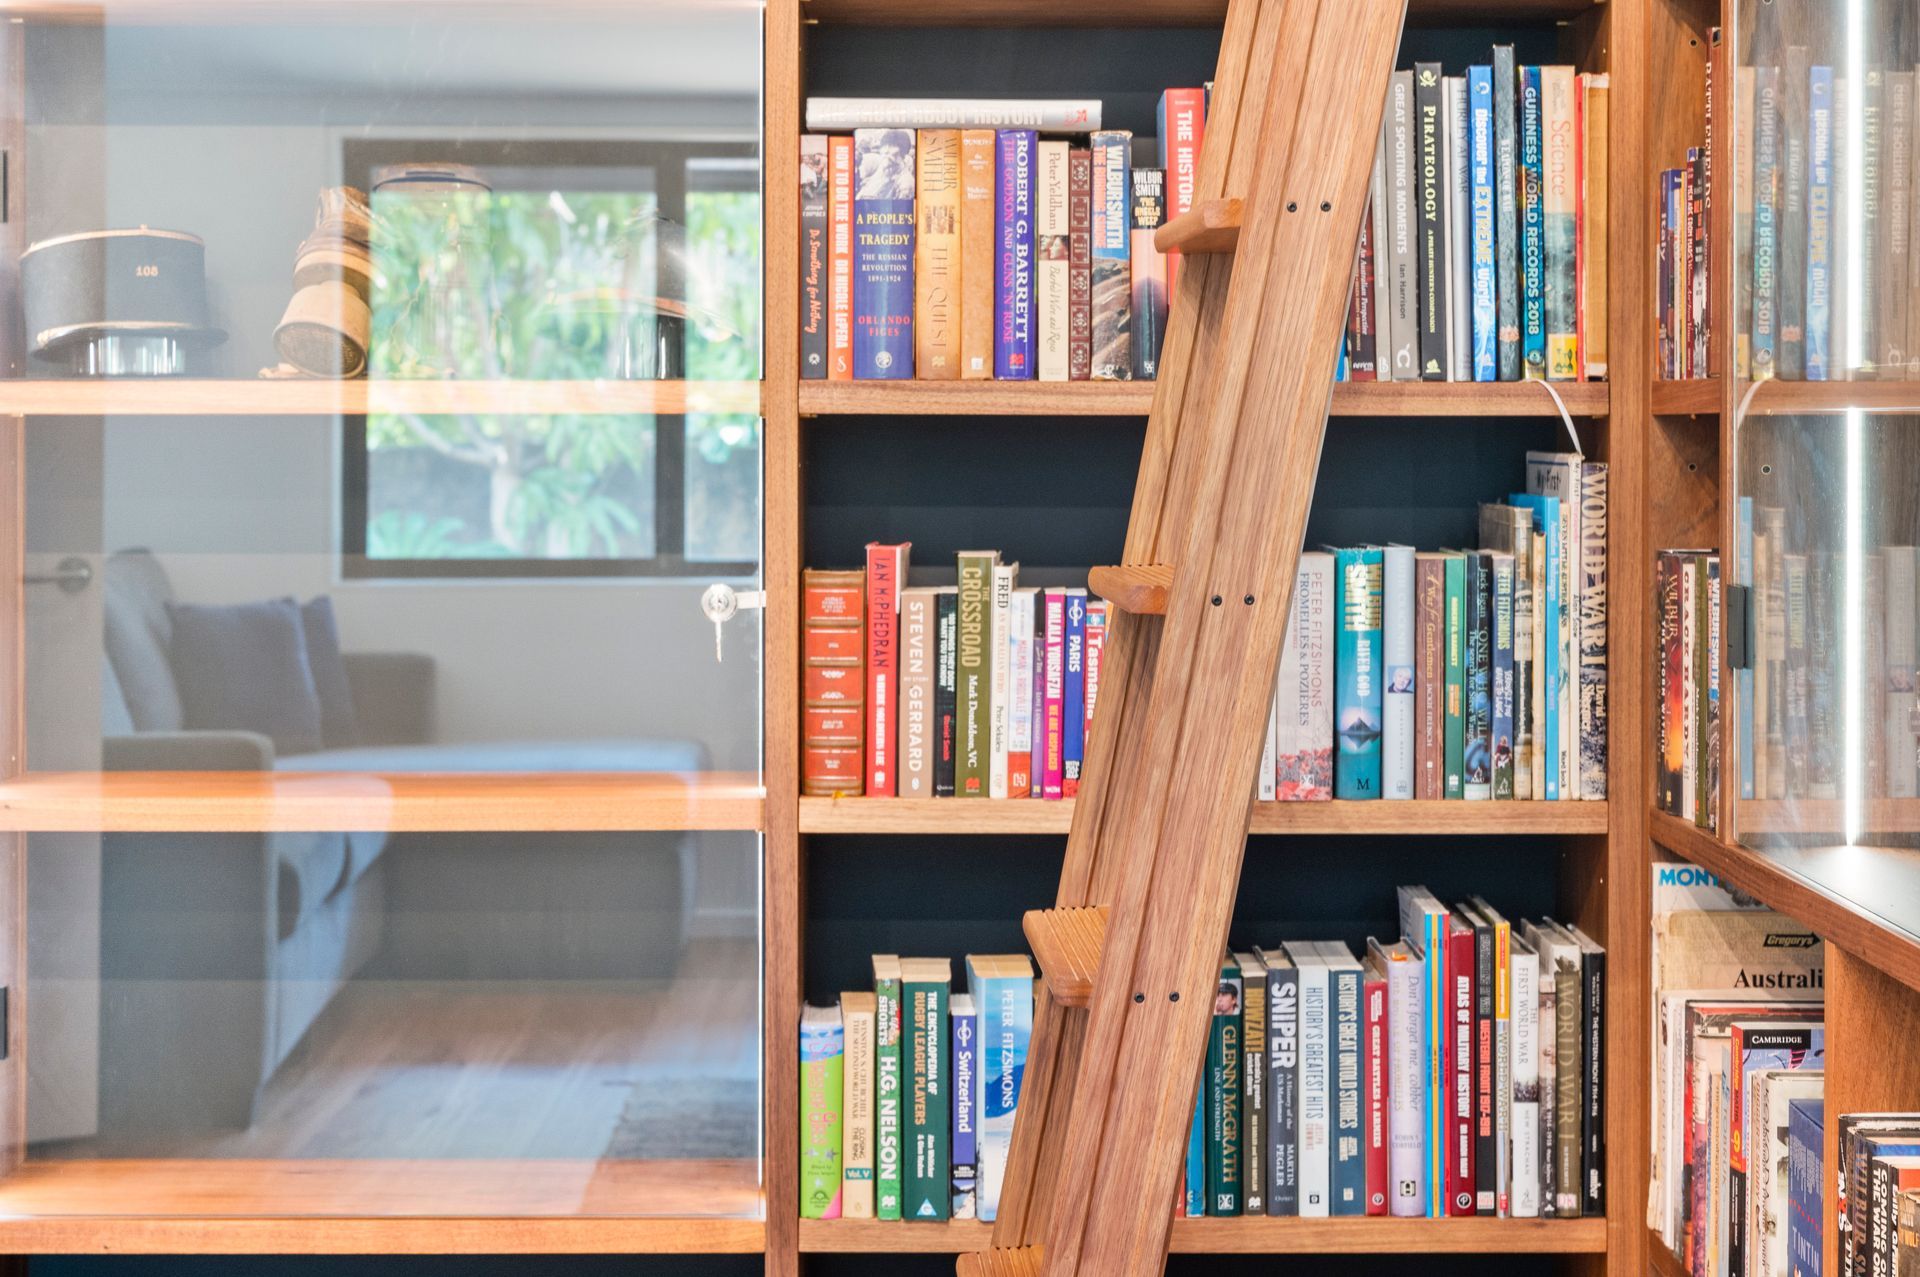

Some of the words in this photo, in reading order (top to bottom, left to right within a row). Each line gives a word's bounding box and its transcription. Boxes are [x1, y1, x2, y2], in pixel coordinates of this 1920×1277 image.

[1395, 83, 1405, 123] GREAT
[1177, 110, 1193, 142] THE
[1475, 108, 1488, 165] Discover
[1525, 87, 1537, 164] GUINNESS
[835, 145, 849, 170] HOW
[924, 136, 944, 192] SMITH
[943, 137, 958, 190] WILBUR
[1003, 139, 1015, 163] THE
[1049, 152, 1061, 180] Peter
[1396, 126, 1406, 187] SPORTING
[1423, 105, 1437, 221] PIRATEOLOGY
[1551, 121, 1571, 195] Science
[835, 172, 849, 185] TO
[835, 187, 849, 201] DO
[1016, 139, 1028, 215] ROBERT
[1133, 171, 1162, 184] WILBUR
[1135, 184, 1160, 196] SMITH
[1476, 167, 1487, 184] the
[835, 202, 849, 222] THE
[1003, 168, 1014, 222] GODSON
[1049, 180, 1063, 230] Yeldham
[1526, 167, 1538, 223] WORLD
[857, 213, 863, 225] A
[867, 213, 913, 225] PEOPLE'S
[1004, 226, 1013, 248] AND
[1016, 220, 1028, 238] G.
[1397, 190, 1407, 254] MOMENTS
[1476, 186, 1491, 265] EXTREME
[835, 223, 849, 254] WORK
[859, 234, 910, 245] TRAGEDY
[862, 264, 907, 272] REVOLUTION
[1003, 252, 1014, 288] GUNS
[1527, 227, 1539, 297] RECORDS
[1016, 243, 1028, 343] BARRETT
[1399, 281, 1407, 319] Harrison
[1477, 268, 1490, 306] World
[804, 300, 821, 334] Nothing
[858, 315, 910, 325] ORLANDO
[869, 327, 899, 336] FIGES
[1002, 311, 1014, 344] ROSE
[1528, 301, 1540, 335] 2018
[1581, 472, 1606, 574] WORLD
[874, 557, 891, 582] IAN
[1478, 568, 1488, 589] Jack
[1498, 567, 1510, 594] PETER
[982, 586, 990, 601] THE
[998, 576, 1009, 608] FRED
[1300, 572, 1310, 649] FROMELLES
[1311, 572, 1322, 615] PETER
[1476, 592, 1488, 618] Egan
[1670, 575, 1678, 639] WILBUR
[962, 567, 982, 667] CROSSROAD
[1047, 601, 1061, 644] MALALA
[1498, 597, 1510, 650] FITZSIMONS
[1581, 584, 1606, 656] WAR
[909, 601, 924, 672] STEVEN
[1069, 634, 1080, 672] PARIS
[1426, 623, 1436, 678] Gentlemen
[1469, 629, 1478, 646] The
[1300, 652, 1307, 661] &
[1311, 621, 1322, 707] FITZSIMONS
[1357, 640, 1370, 673] RIVER
[968, 674, 978, 699] Mark
[1357, 675, 1370, 696] GOD
[1468, 679, 1477, 689] for
[909, 685, 924, 772] GERRARD
[1408, 976, 1420, 1007] Don't
[1458, 976, 1470, 1008] ATLAS
[1518, 968, 1528, 994] FIRST
[1734, 968, 1823, 988] Australi
[914, 992, 926, 1029] RUGBY
[928, 992, 938, 1010] THE
[1002, 989, 1014, 1026] PETER
[1306, 987, 1324, 1040] HISTORY'S
[1339, 974, 1358, 1021] HISTORY'S
[1458, 1009, 1470, 1023] OF
[878, 995, 888, 1046] SHORTS
[1245, 988, 1264, 1052] HOWZAT!
[1272, 982, 1296, 1068] SNIPER
[1339, 1022, 1358, 1051] GREAT
[1406, 1010, 1420, 1044] forget
[1518, 999, 1528, 1038] WORLD
[1558, 980, 1574, 1066] WORLD
[1591, 1016, 1599, 1025] THE
[914, 1031, 926, 1074] LEAGUE
[928, 1012, 938, 1080] ENCYCLOPEDIA
[1223, 1024, 1236, 1088] GLENN
[1458, 1024, 1470, 1072] MILITARY
[1480, 1020, 1491, 1063] WESTERN
[1518, 1041, 1528, 1064] WAR
[1591, 1026, 1599, 1060] WESTERN
[1752, 1035, 1802, 1044] CAMBRIDGE
[880, 1056, 896, 1096] H.G.
[1002, 1032, 1014, 1108] FITZSIMONS
[1306, 1043, 1324, 1092] GREATEST
[1339, 1052, 1358, 1088] UNTOLD
[1498, 1032, 1508, 1086] WORLD
[1591, 1061, 1599, 1084] FRONT
[928, 1082, 938, 1096] OF
[958, 1051, 972, 1133] Switzerland
[1278, 1074, 1284, 1083] US
[1410, 1074, 1422, 1111] cobber
[1458, 1073, 1470, 1118] HISTORY
[1480, 1064, 1491, 1094] FRONT
[914, 1076, 926, 1126] PLAYERS
[1286, 1108, 1292, 1116] of
[1306, 1096, 1324, 1119] HITS
[1339, 1090, 1358, 1128] STORIES
[1498, 1087, 1508, 1118] WAR
[1558, 1074, 1574, 1124] WAR
[880, 1099, 896, 1180] NELSON
[1223, 1092, 1236, 1183] McGRATH
[1733, 1130, 1741, 1152] 9
[1276, 1144, 1284, 1186] PEGLER
[1286, 1144, 1294, 1186] MARTIN
[1855, 1152, 1868, 1245] WILBUR
[1873, 1168, 1881, 1202] THE
[1873, 1207, 1881, 1250] WAR
[1880, 1168, 1888, 1254] COMING
[1792, 1226, 1820, 1275] TINTIN
